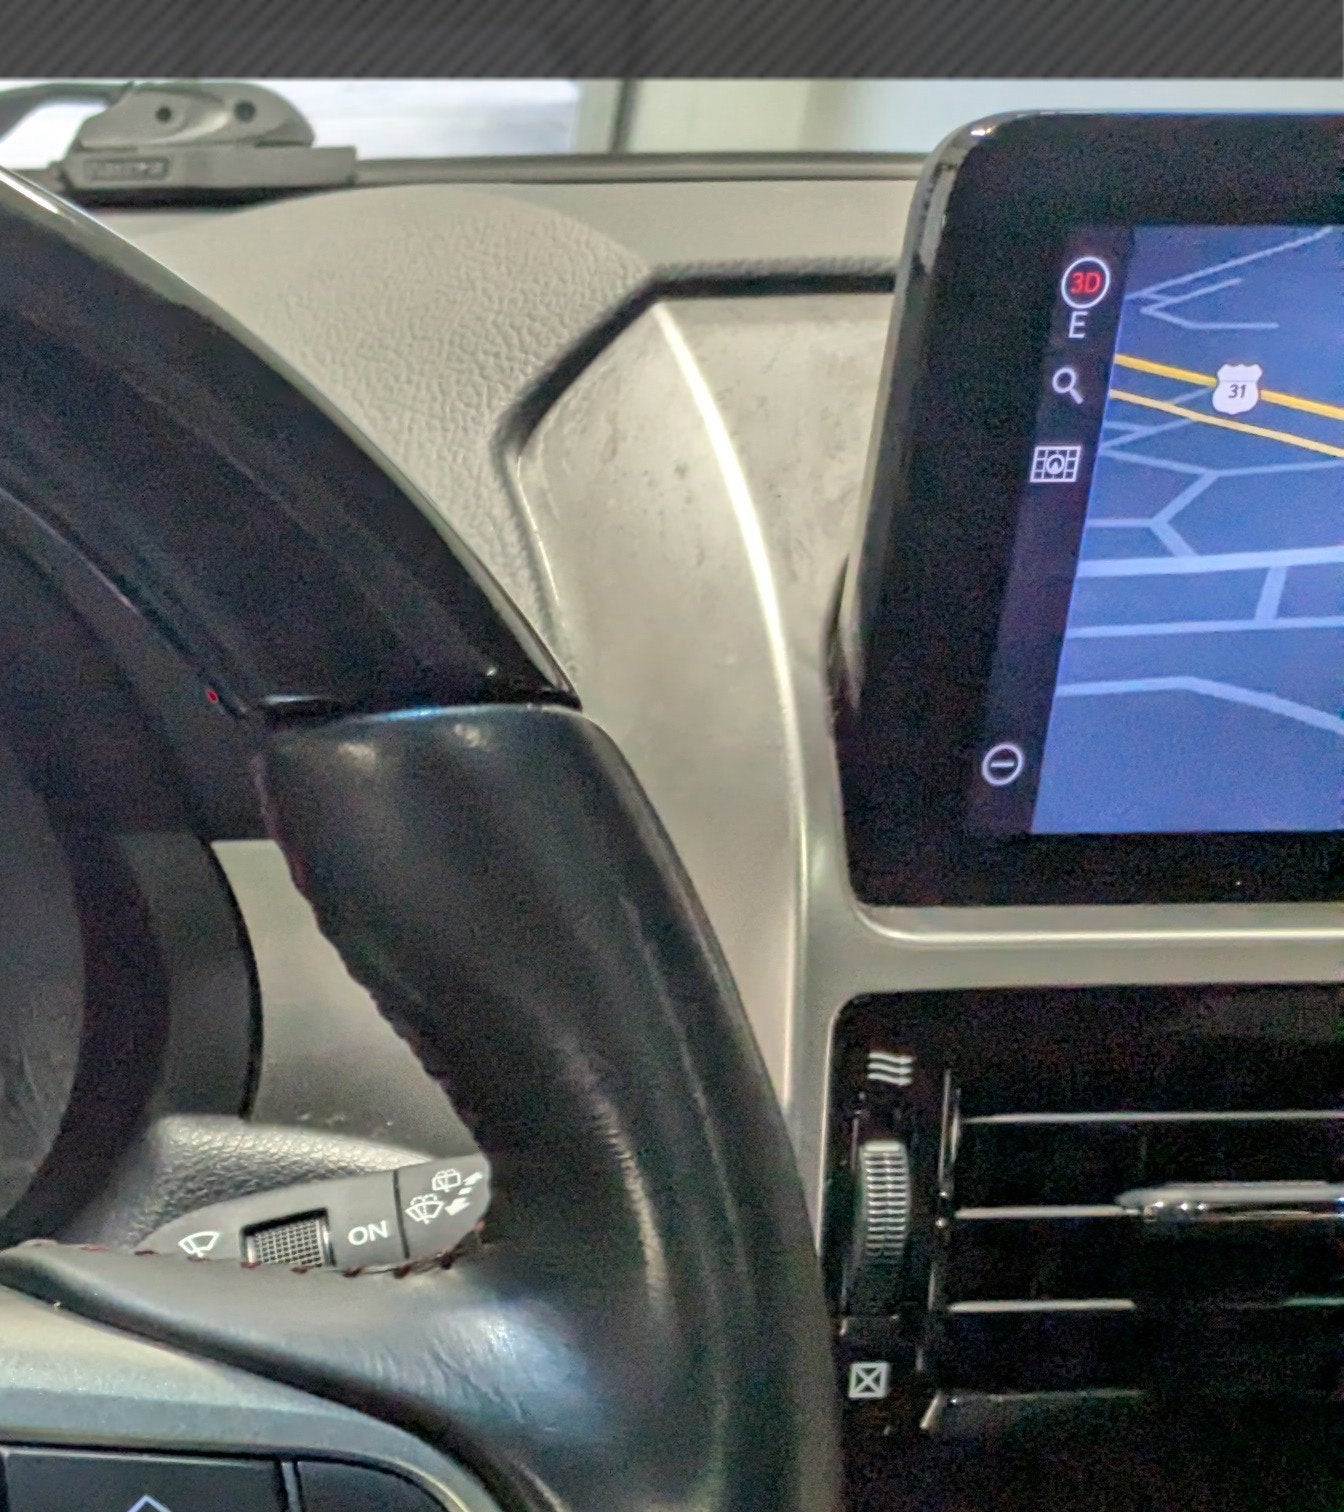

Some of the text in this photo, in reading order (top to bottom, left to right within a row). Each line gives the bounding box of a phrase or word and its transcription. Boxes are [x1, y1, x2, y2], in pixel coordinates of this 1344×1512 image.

[1069, 271, 1104, 294] 3D
[1069, 310, 1089, 339] E
[1228, 384, 1247, 399] 31
[347, 1219, 390, 1246] ON
